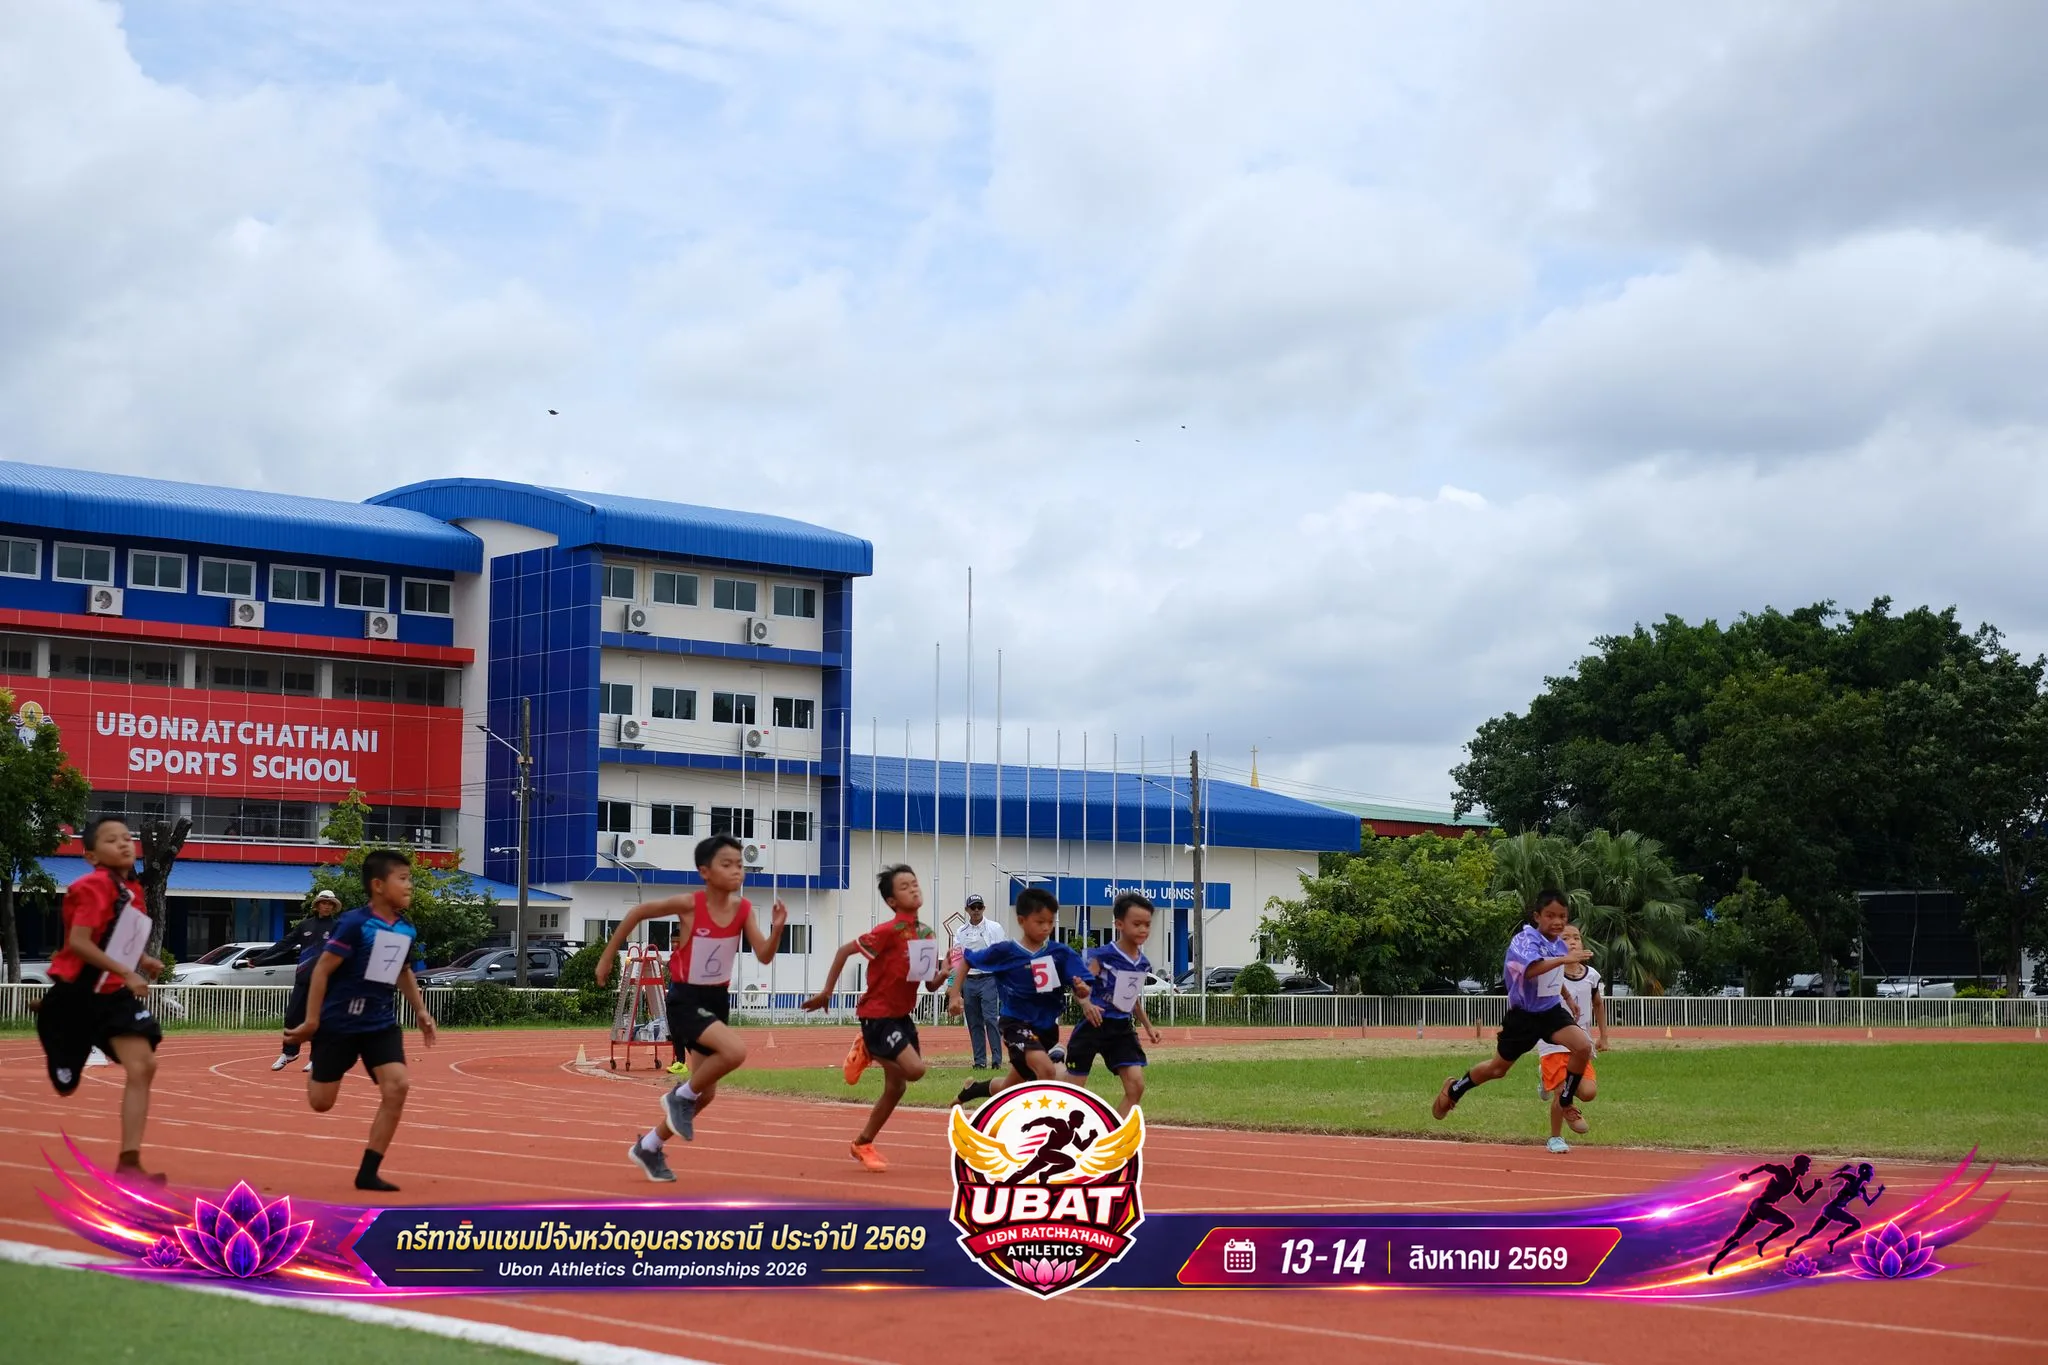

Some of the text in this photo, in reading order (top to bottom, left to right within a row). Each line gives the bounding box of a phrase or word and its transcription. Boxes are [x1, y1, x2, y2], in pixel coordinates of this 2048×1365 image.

[96, 711, 379, 753] UBONRATCHATHANI
[129, 748, 356, 783] SPORTS SCHOOL
[383, 944, 401, 972] 7
[704, 943, 722, 975] 6
[917, 946, 935, 976] 5
[1031, 963, 1049, 988] 5
[1122, 976, 1138, 1000] 3
[347, 997, 366, 1016] 10
